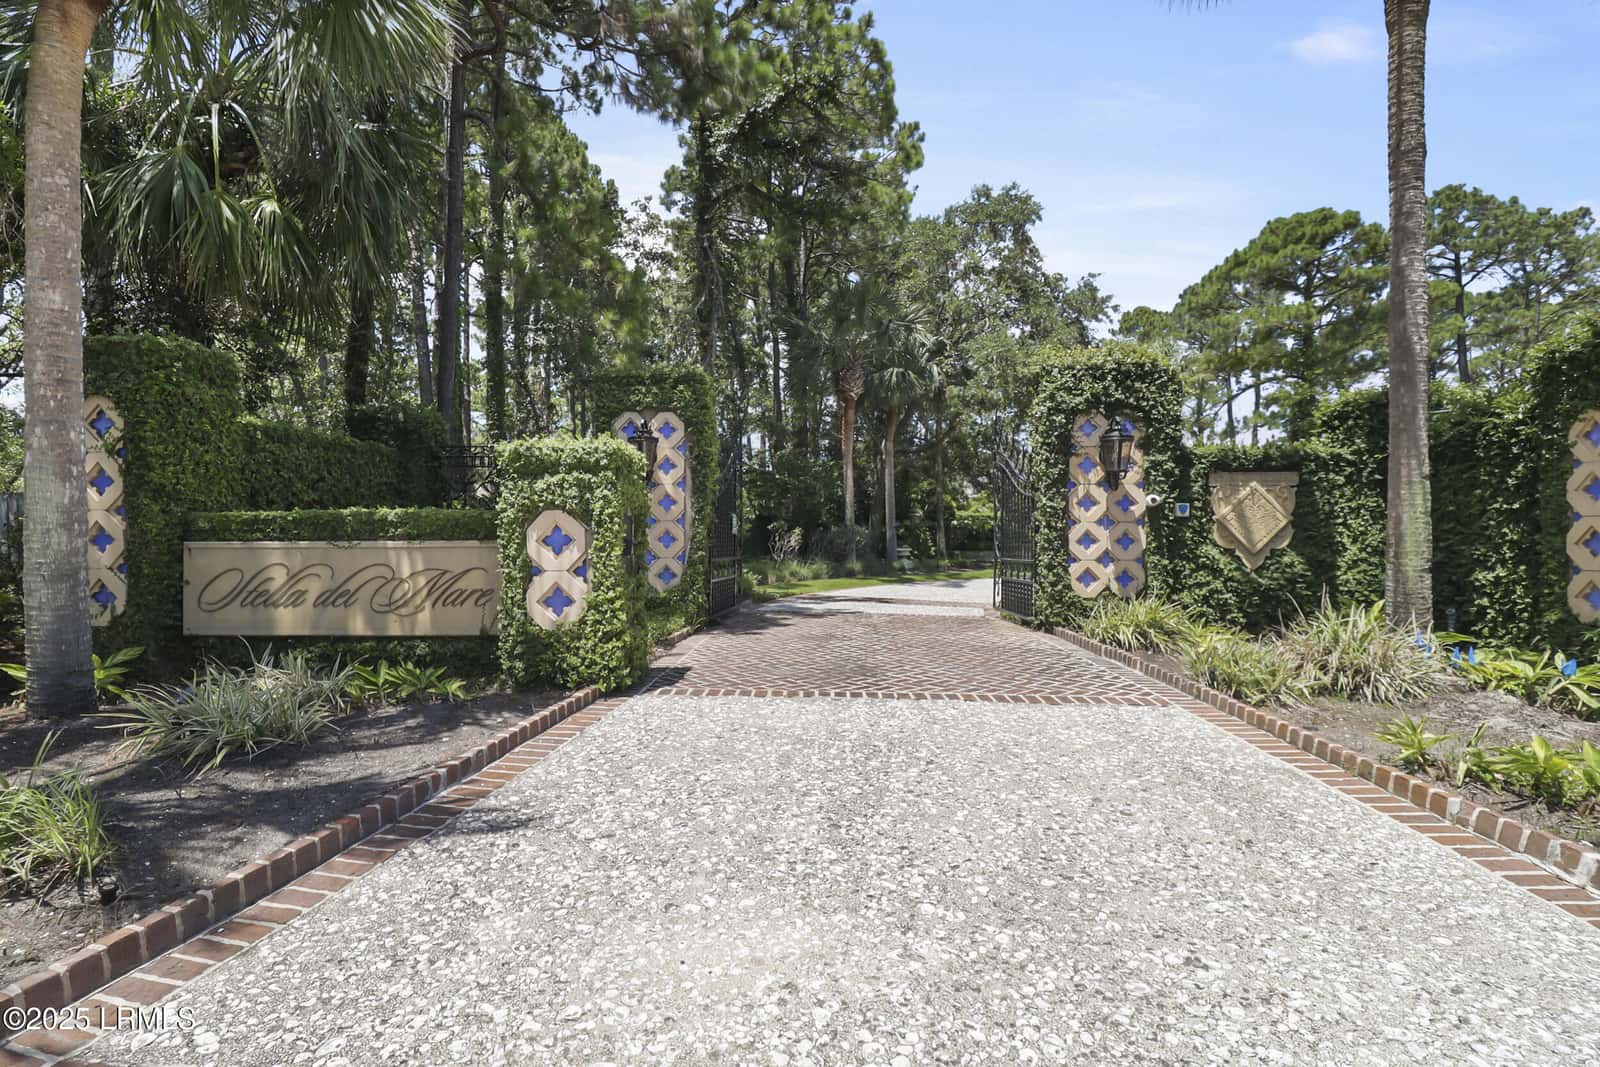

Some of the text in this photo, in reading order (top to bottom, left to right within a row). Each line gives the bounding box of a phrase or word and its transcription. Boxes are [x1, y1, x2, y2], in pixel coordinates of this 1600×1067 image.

[198, 563, 496, 617] Stella del Mare
